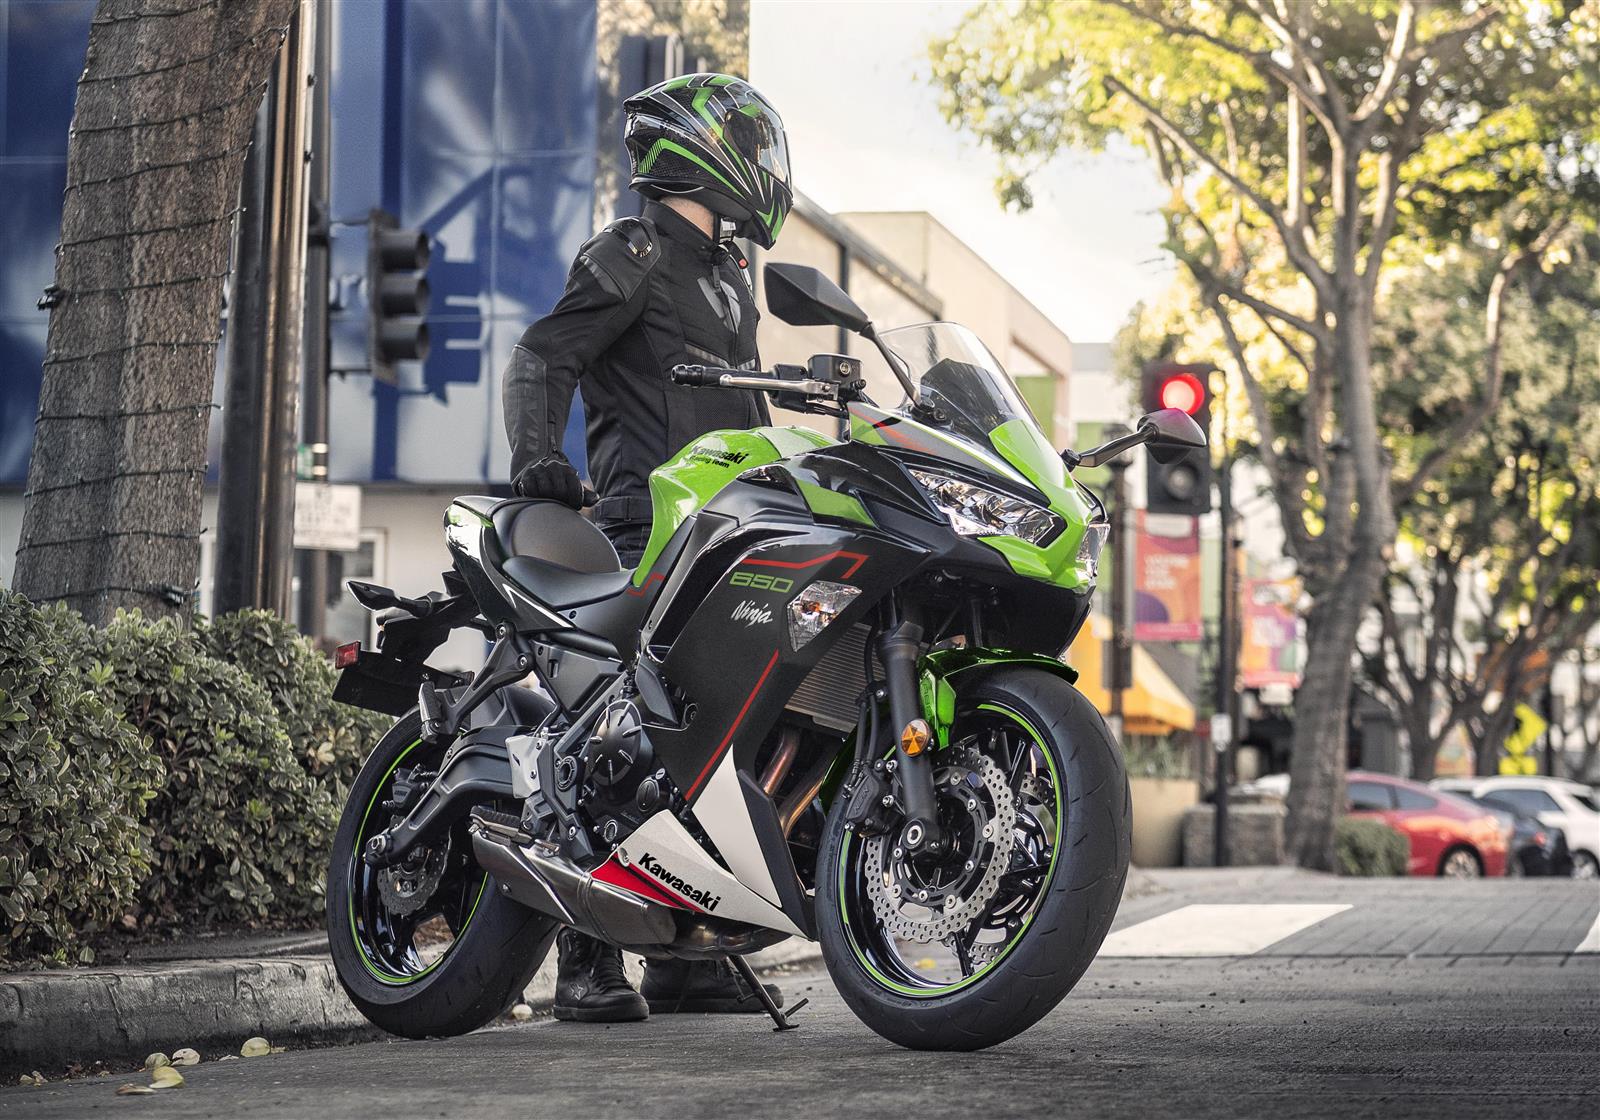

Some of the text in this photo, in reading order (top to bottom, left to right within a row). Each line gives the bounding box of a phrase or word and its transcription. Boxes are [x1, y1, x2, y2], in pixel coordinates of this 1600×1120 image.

[692, 446, 749, 464] Kawasaki
[730, 573, 794, 593] 650
[731, 600, 773, 627] Ninja
[639, 853, 721, 912] Kawasaki
